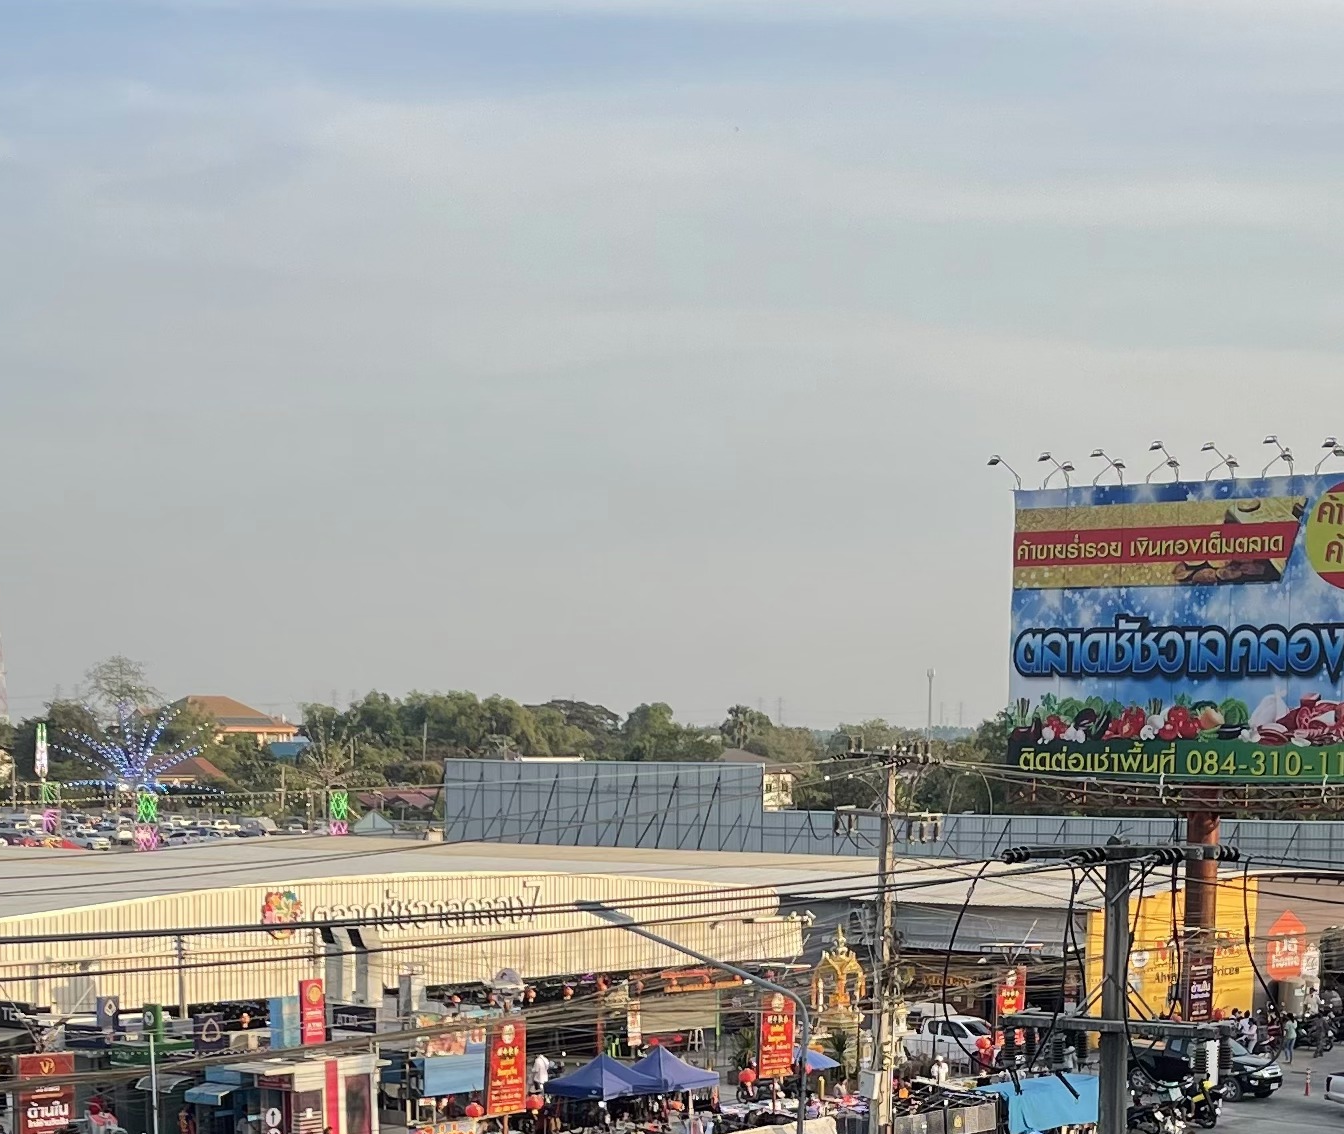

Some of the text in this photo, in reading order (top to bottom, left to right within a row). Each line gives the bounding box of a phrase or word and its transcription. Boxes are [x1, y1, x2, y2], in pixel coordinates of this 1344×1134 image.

[1017, 529, 1285, 562] ค้าขายร่ำรวย เงินทองเต็มตลาด
[1018, 738, 1177, 775] ติดต่อเช่าพื้นที่
